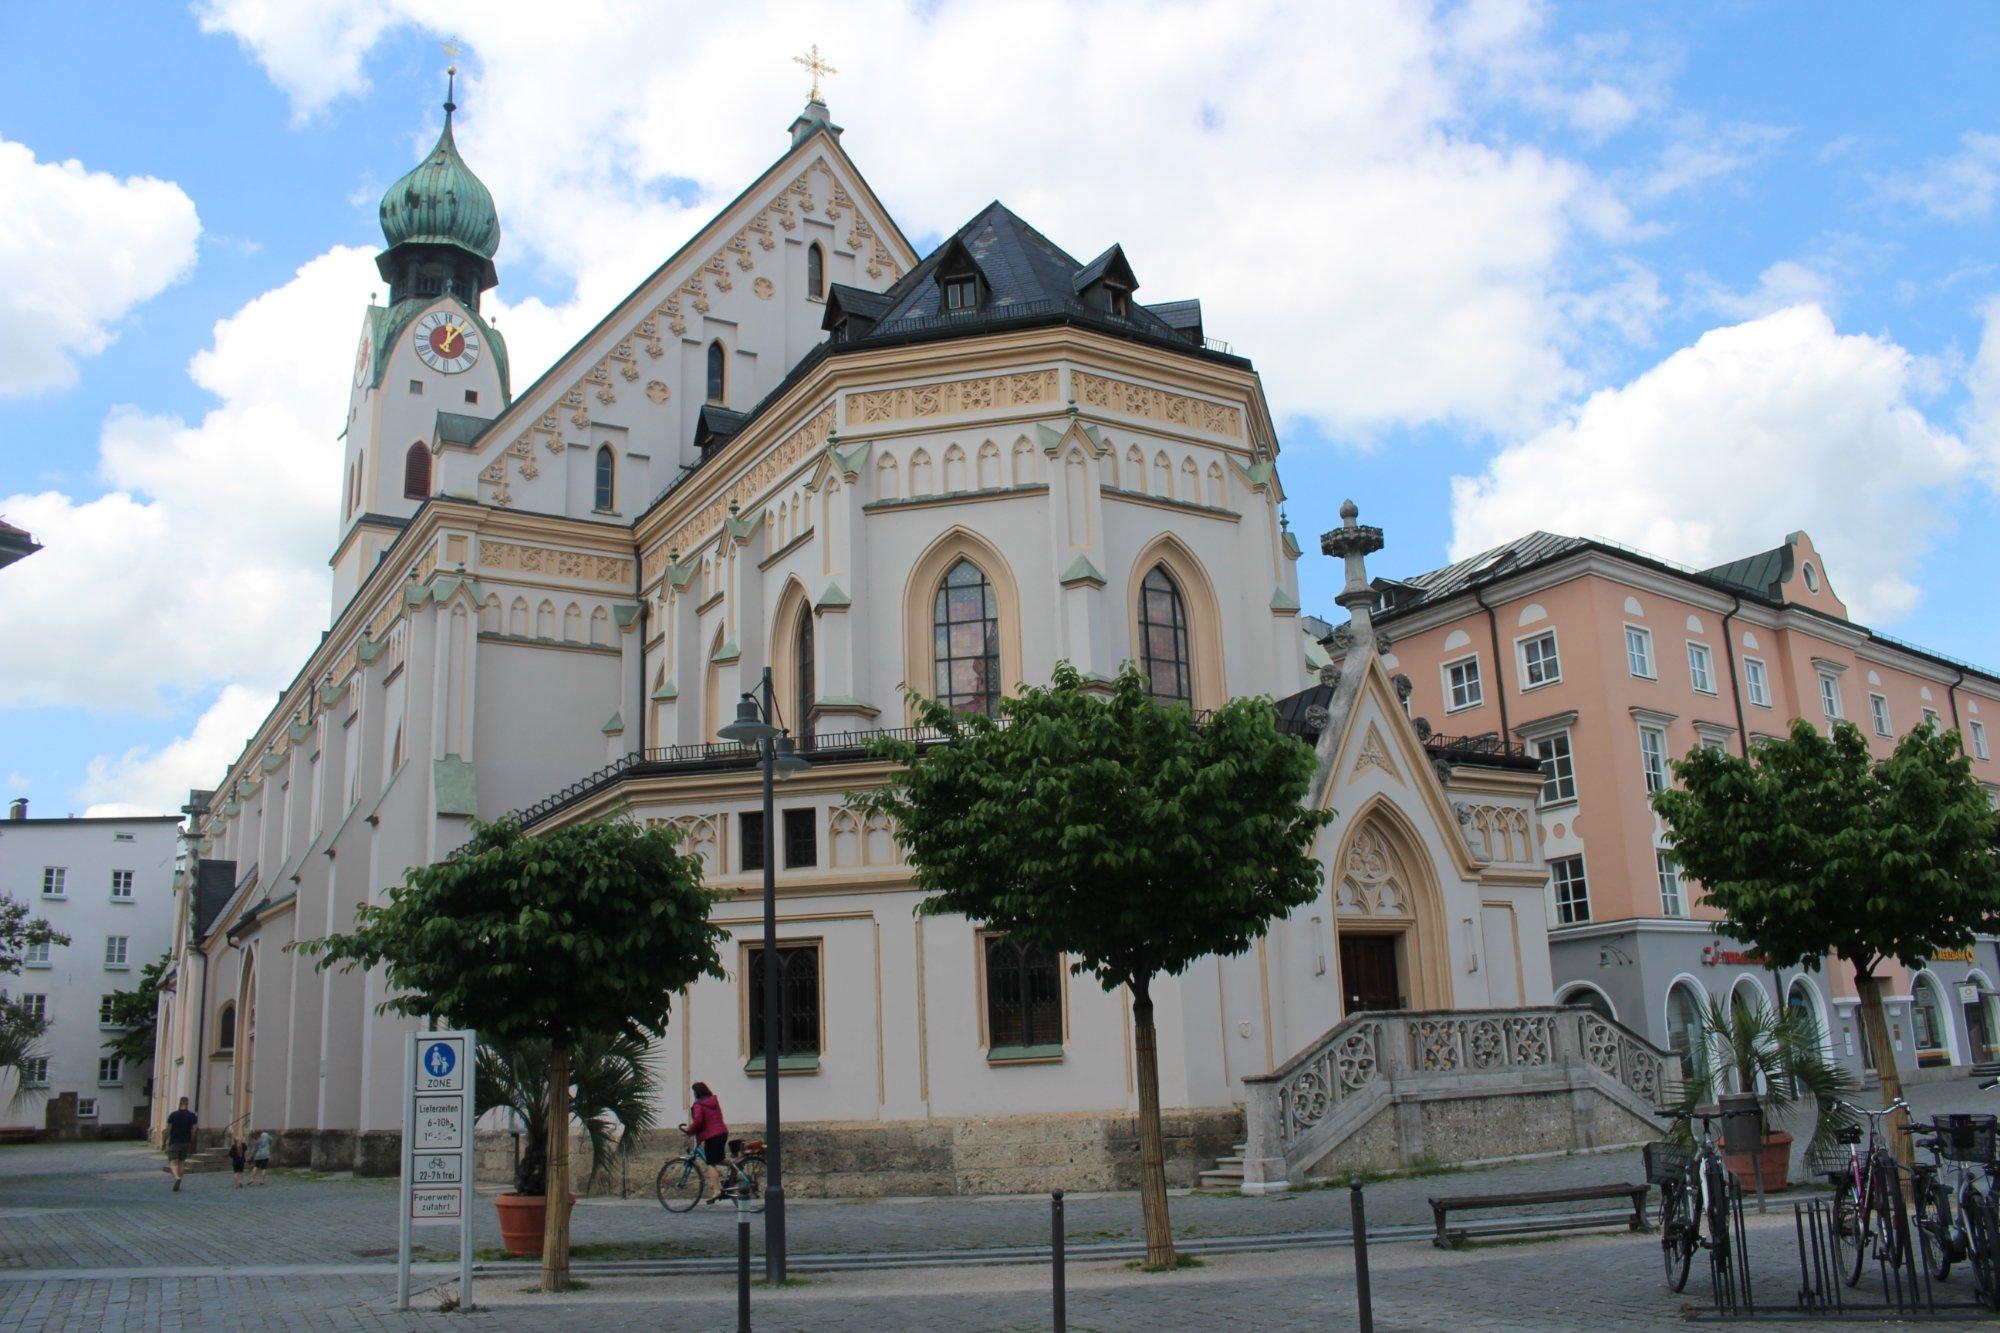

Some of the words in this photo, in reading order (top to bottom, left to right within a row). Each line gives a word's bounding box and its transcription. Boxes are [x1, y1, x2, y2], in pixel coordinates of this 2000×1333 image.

[427, 1079, 452, 1088] ZONE
[419, 1104, 459, 1113] Lieferzeiten
[442, 1171, 455, 1180] frei
[422, 1203, 450, 1211] zufahrt
